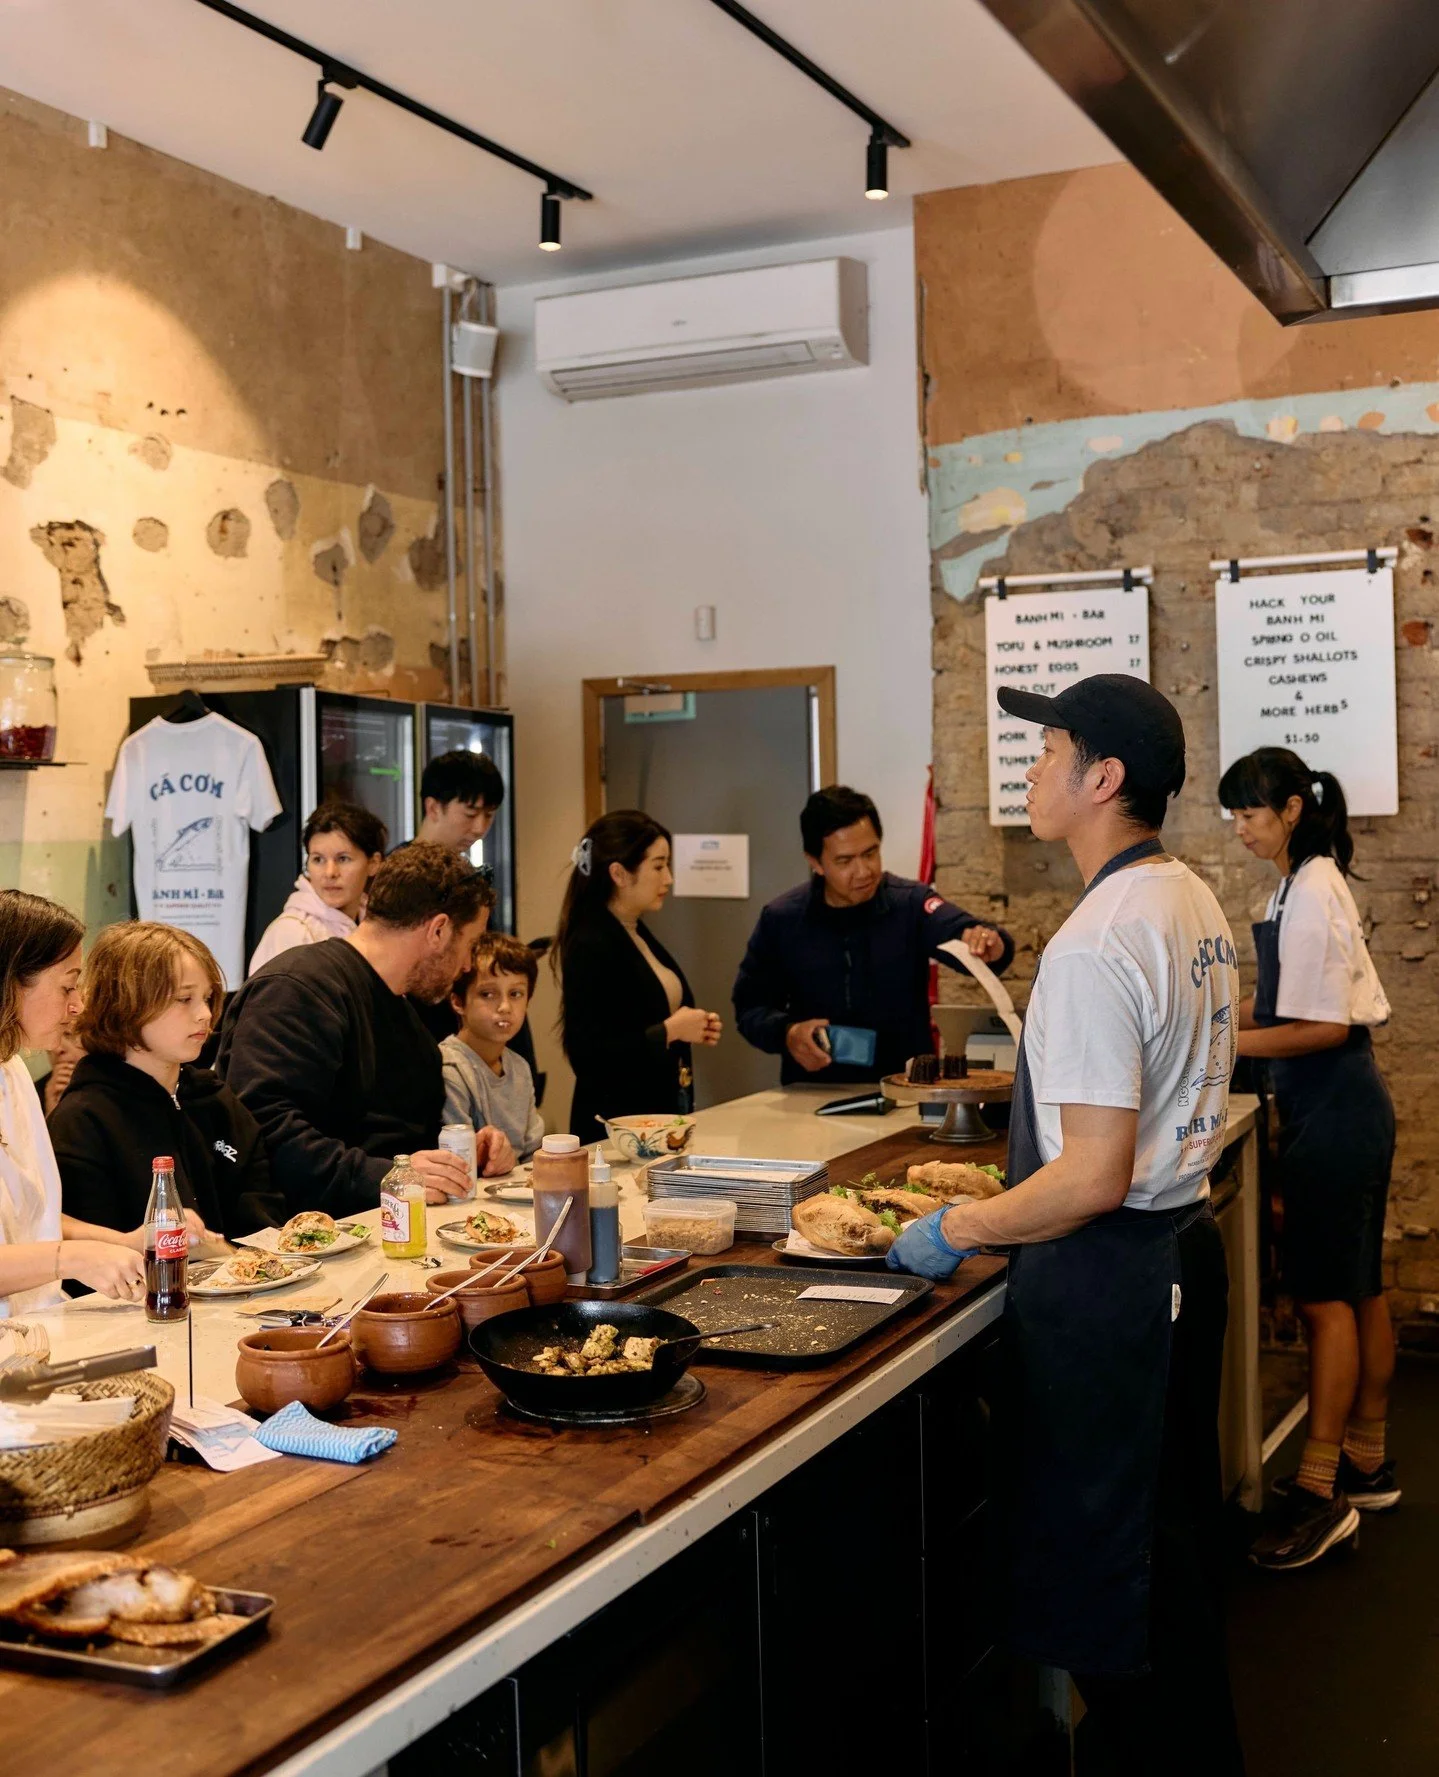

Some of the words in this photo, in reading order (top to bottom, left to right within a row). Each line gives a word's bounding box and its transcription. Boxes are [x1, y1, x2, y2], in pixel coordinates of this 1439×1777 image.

[1250, 599, 1285, 609] HACK
[1300, 593, 1336, 605] YOUR
[1016, 614, 1047, 624] BANH
[1082, 610, 1105, 620] BAR
[1266, 615, 1303, 625] BANH
[1310, 614, 1324, 624] MI
[1300, 632, 1310, 642] O
[1316, 632, 1338, 642] OIL
[996, 641, 1025, 652] TOFU
[1047, 637, 1112, 649] MUSHROOM
[1244, 654, 1287, 667] CRISPY
[1294, 650, 1358, 664] SHALLOTS
[994, 664, 1038, 674] HONEST
[1268, 672, 1328, 685] CASHEWS
[1032, 683, 1056, 694] CUT
[1260, 706, 1296, 717] MORE
[1305, 699, 1348, 716] HERBS
[998, 732, 1027, 742] PORK
[999, 756, 1038, 766] TUMER
[150, 772, 176, 800] CÁ
[1000, 781, 1027, 792] PORK
